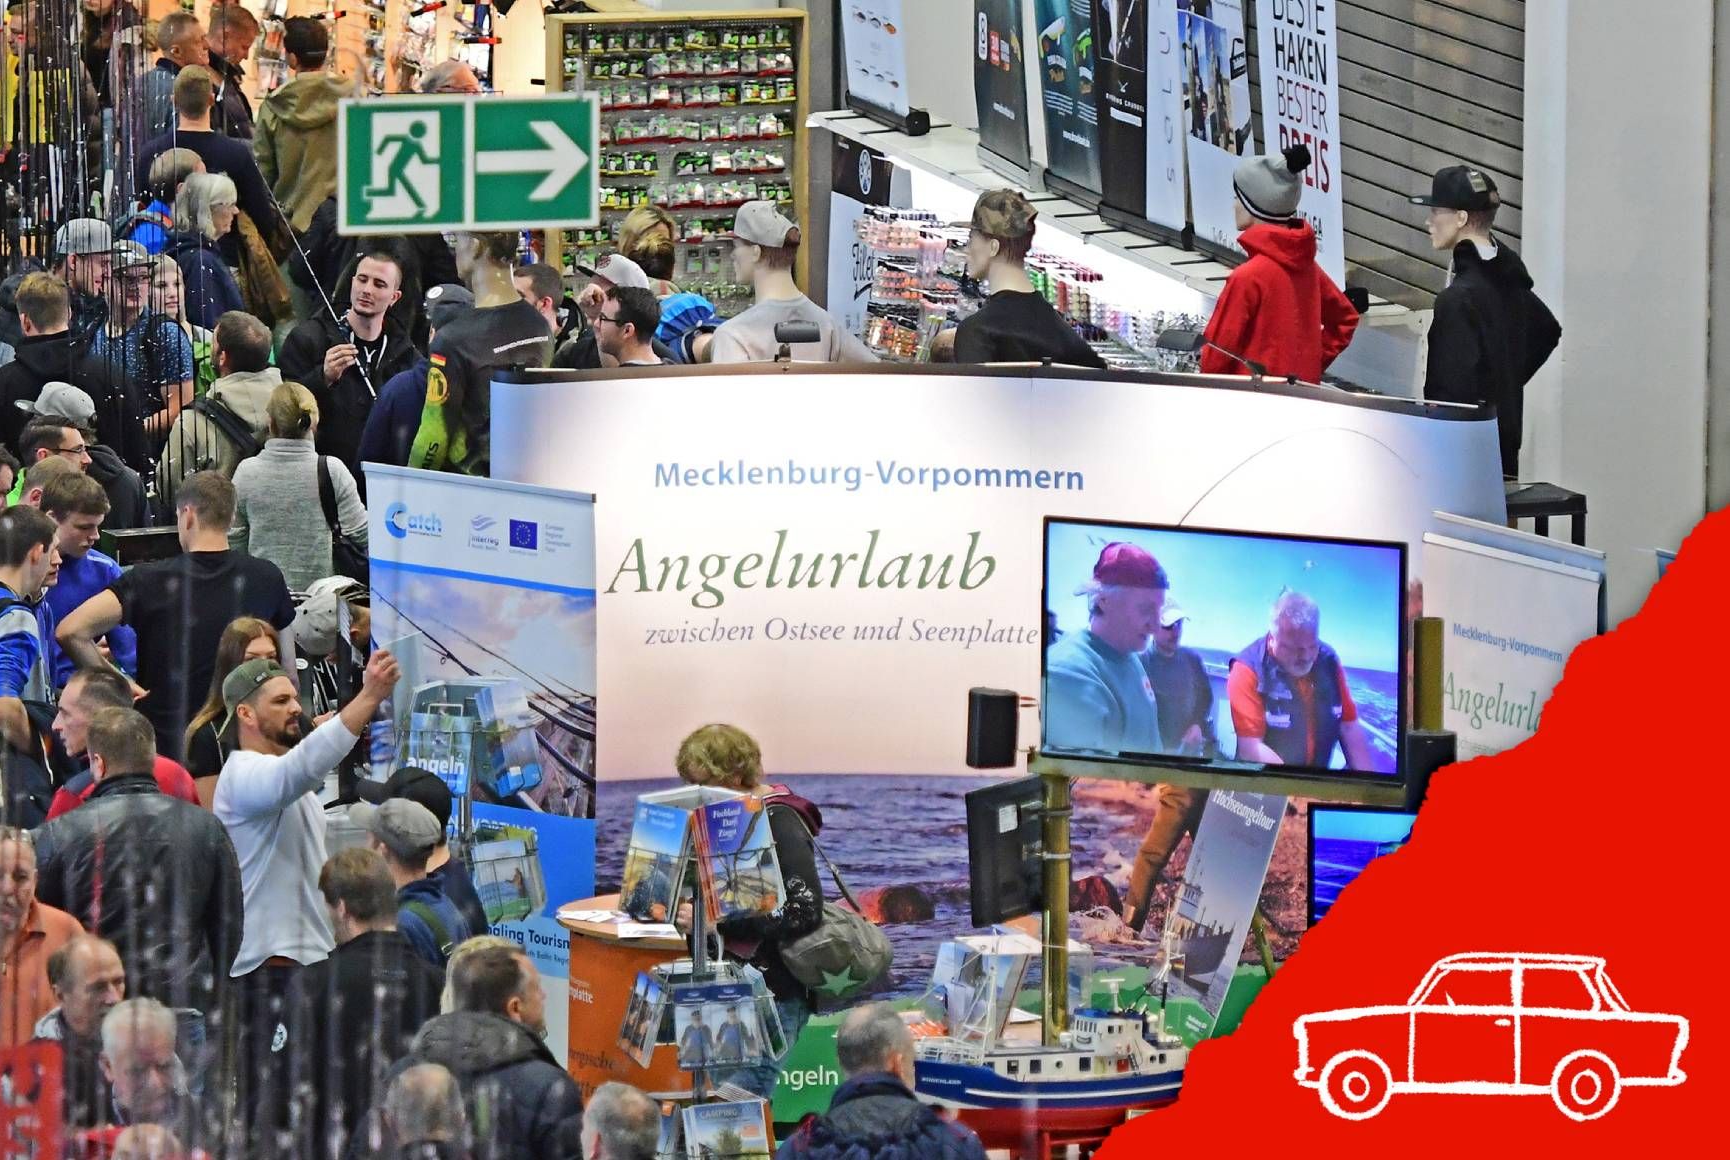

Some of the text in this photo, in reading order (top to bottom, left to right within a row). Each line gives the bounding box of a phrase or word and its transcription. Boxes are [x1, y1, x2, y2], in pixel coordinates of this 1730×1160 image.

[1274, 28, 1327, 85] HAKEN
[1278, 75, 1328, 133] BESTER
[655, 459, 1084, 492] Mecklenburg-Vorpommern
[385, 501, 442, 539] Catch
[604, 530, 997, 610] Angelurlaub
[645, 617, 1039, 650] zwischen Ostsee und Seenplatte
[1453, 623, 1562, 662] Mecklenburg-Vorpommern
[777, 1065, 839, 1091] ngeln
